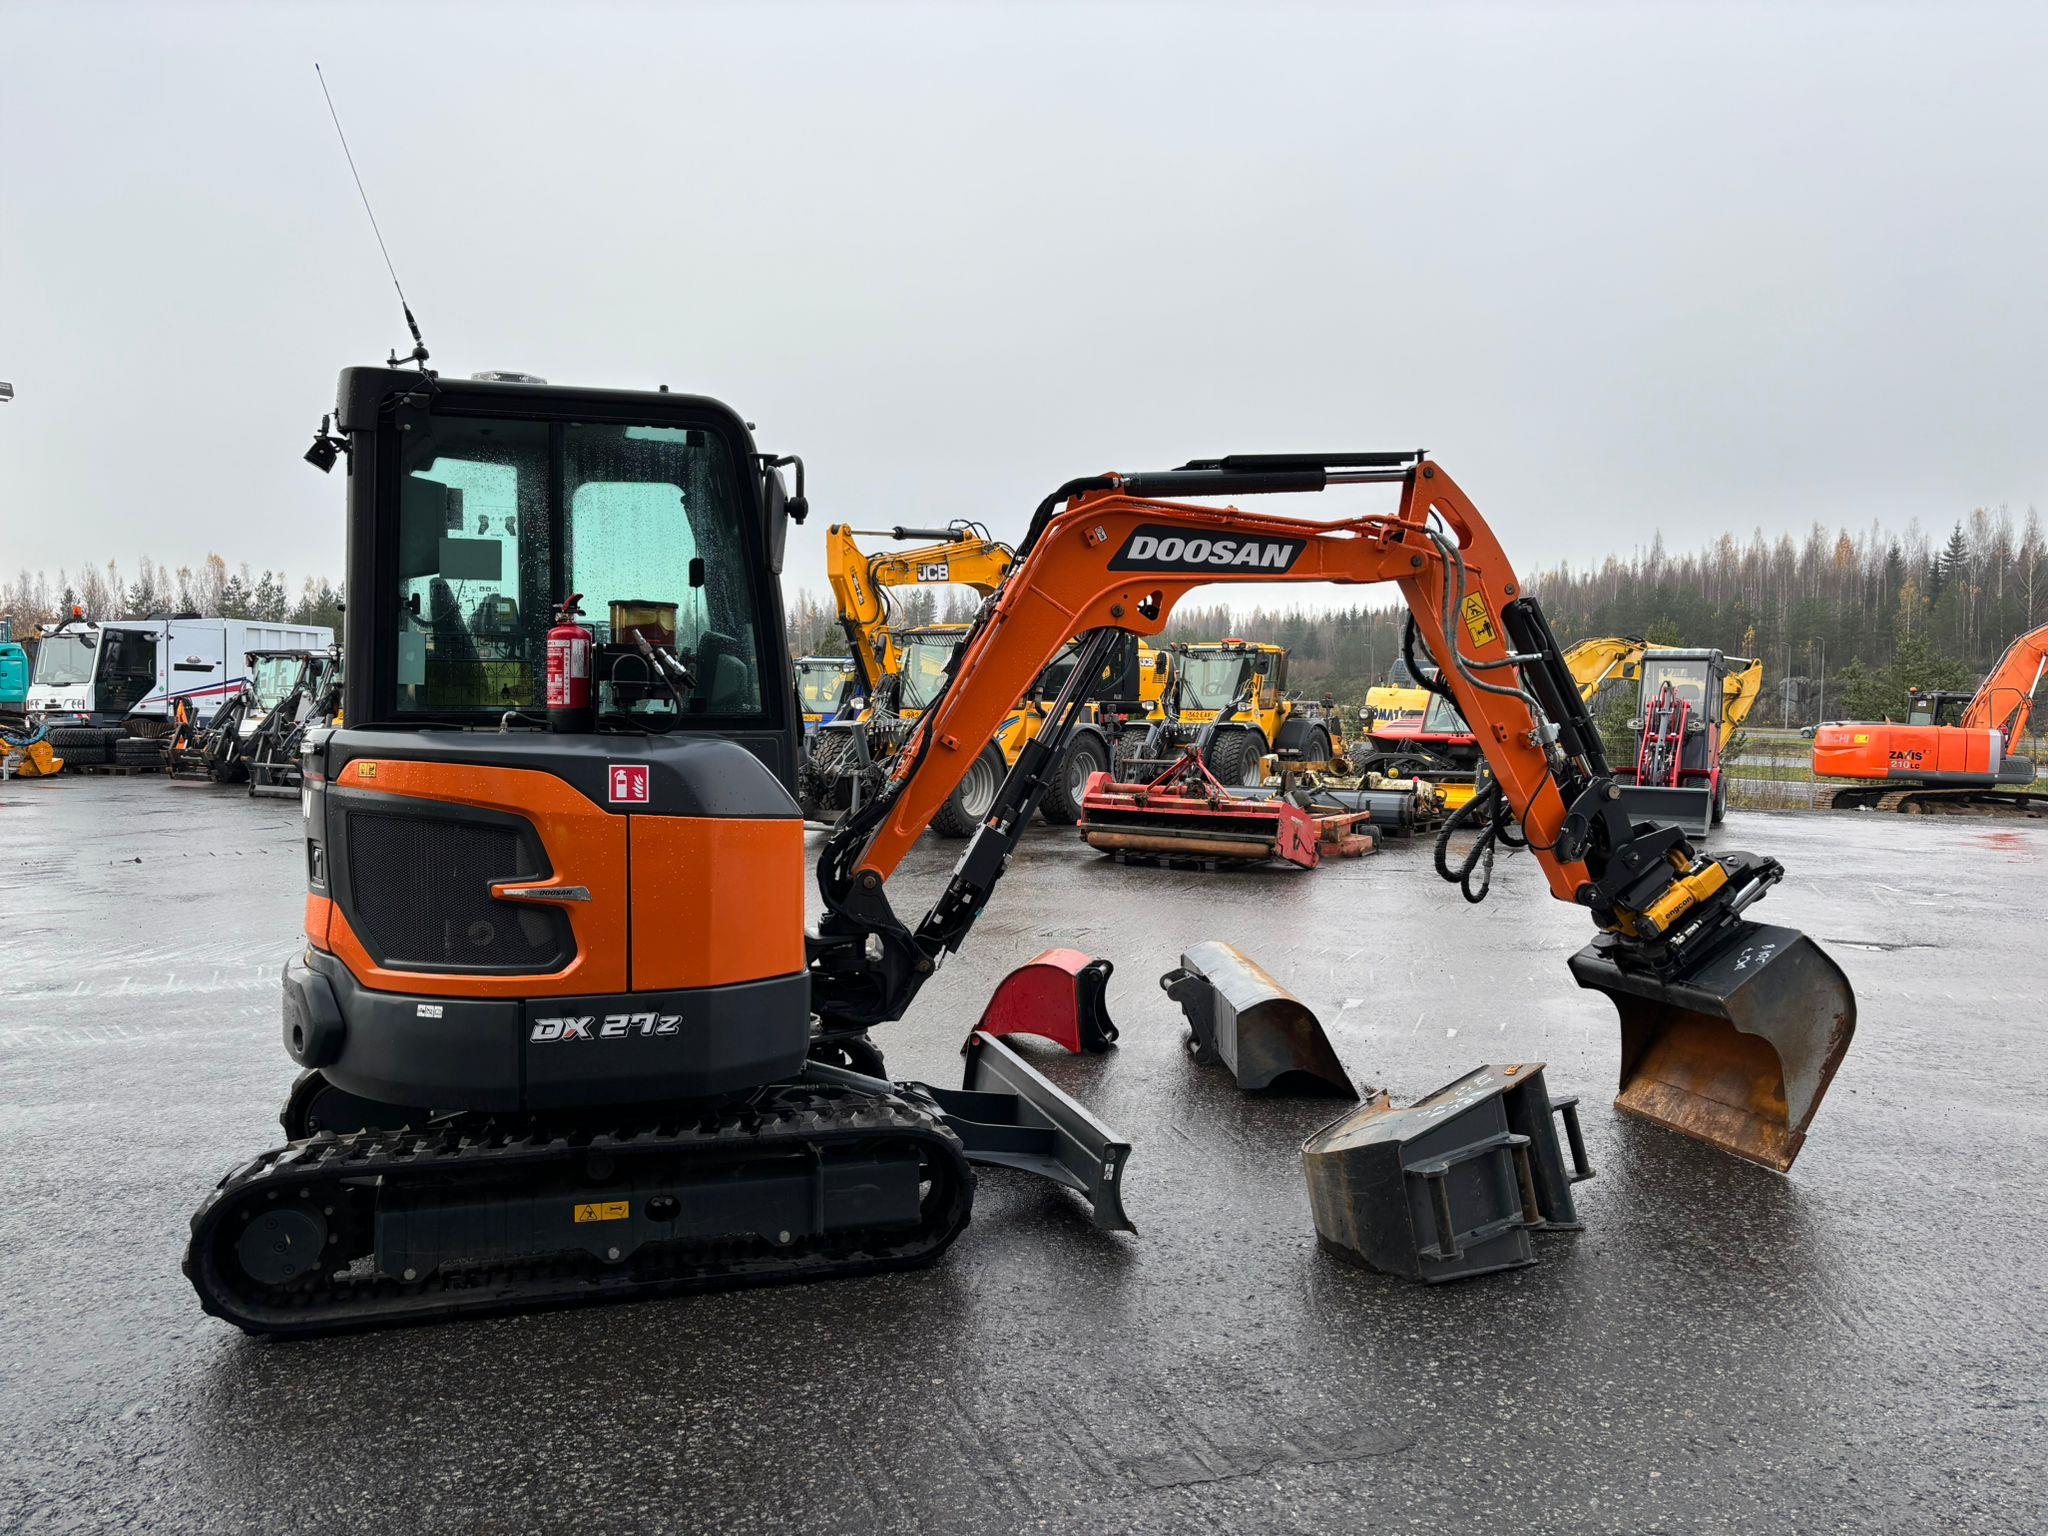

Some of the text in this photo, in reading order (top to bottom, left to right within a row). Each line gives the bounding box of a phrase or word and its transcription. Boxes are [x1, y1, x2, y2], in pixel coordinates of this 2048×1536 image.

[1127, 535, 1293, 568] DOOSAN
[917, 563, 949, 581] JCB
[1889, 750, 1922, 760] ZAXIS
[1665, 896, 1692, 919] engcon
[530, 1016, 596, 1043] DX
